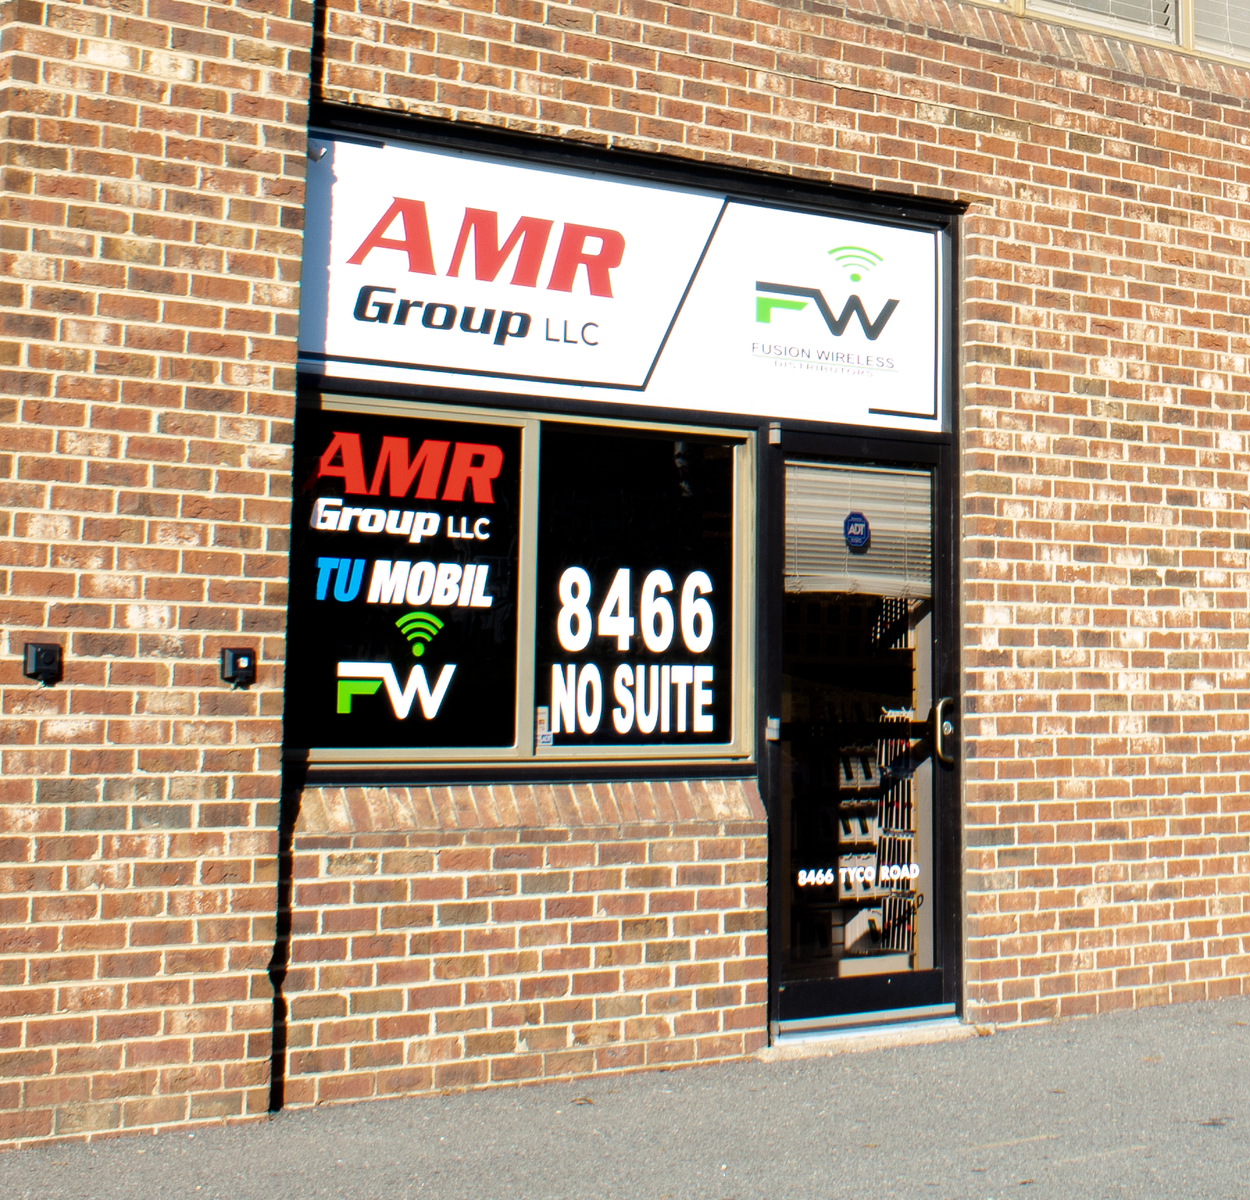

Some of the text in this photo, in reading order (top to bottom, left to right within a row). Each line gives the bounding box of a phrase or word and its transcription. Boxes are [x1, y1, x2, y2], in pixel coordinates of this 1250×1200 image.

[346, 196, 625, 298] AMR
[353, 285, 599, 347] Group LLC
[755, 281, 900, 341] FW
[751, 342, 895, 369] FUSION WIRELESS
[774, 360, 874, 378] DISTRIBUTORS
[303, 431, 504, 504] AMR
[310, 497, 490, 543] Group LLC
[848, 523, 865, 535] ADT
[316, 557, 494, 608] TU MOBIL
[557, 566, 714, 653] 8466
[337, 661, 457, 720] FW
[551, 662, 714, 734] NO SUITE
[798, 863, 920, 886] 8466 TYCO ROAD
